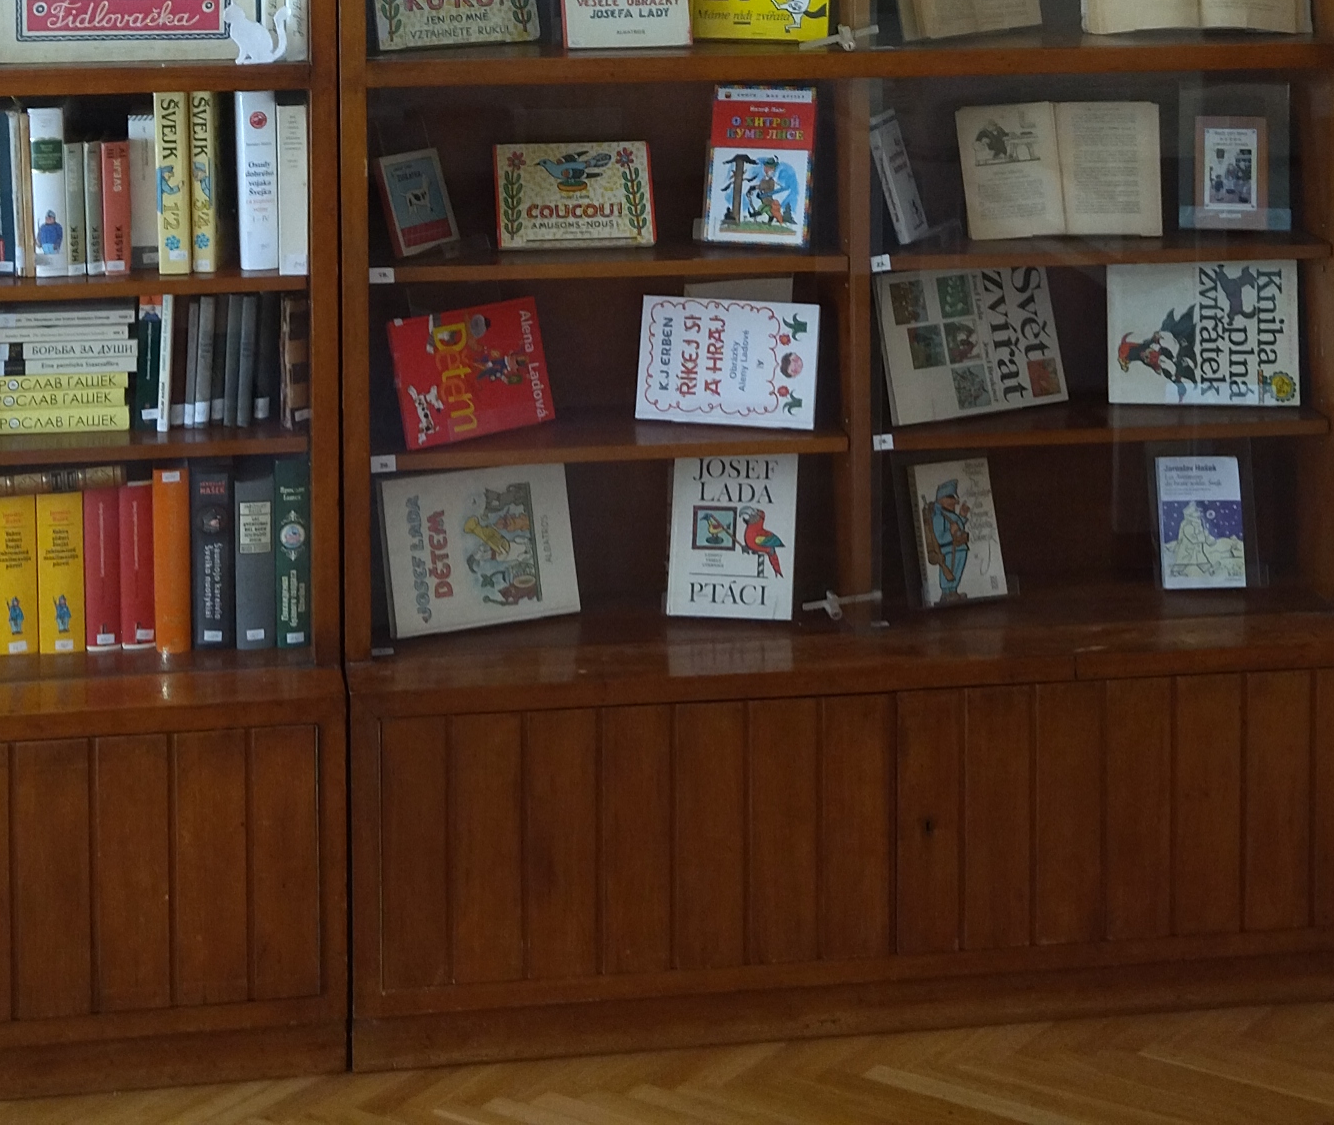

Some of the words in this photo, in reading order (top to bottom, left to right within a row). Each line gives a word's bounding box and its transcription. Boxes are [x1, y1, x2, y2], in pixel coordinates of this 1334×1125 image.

[46, 0, 200, 28] Fidlovačka
[424, 15, 445, 25] JEN
[449, 14, 463, 24] PO
[465, 9, 490, 22] MNĚ
[590, 9, 634, 19] JOSEFA
[639, 7, 670, 18] LADY
[734, 9, 752, 21] rádi
[160, 98, 180, 160] ŠVEJK
[192, 96, 209, 158] ŠVEJK
[727, 129, 763, 139] КУМЕ
[767, 129, 804, 140] ЛИСЕ
[745, 115, 800, 127] ХИТРОЙ
[113, 158, 122, 192] ŠVEJK
[246, 169, 274, 178] dobrého
[248, 161, 272, 171] Osudy
[248, 187, 272, 196] Švejka
[526, 202, 623, 219] COUCOU!
[72, 227, 80, 262] HAŠEK
[92, 227, 100, 262] HAŠEK
[116, 225, 124, 261] HAŠEK
[683, 314, 702, 334] SI
[1010, 266, 1051, 361] Svět
[1256, 268, 1284, 368] Kniha
[660, 317, 674, 369] ERBEN
[706, 315, 726, 372] HRAJ
[741, 329, 750, 364] Ladové
[981, 270, 1029, 403] zvířat
[1199, 266, 1226, 396] zvířátek
[32, 346, 75, 355] БОРЬБА
[80, 346, 95, 355] ЗА
[98, 344, 133, 355] ДУШИ
[519, 310, 535, 353] Alena
[528, 362, 549, 419] Ladová
[729, 341, 741, 379] Obrázky
[1223, 324, 1255, 402] plná
[68, 375, 117, 387] ГАШЕК
[433, 322, 477, 432] Dětem
[675, 339, 700, 398] ŘÍKEJ
[738, 366, 749, 392] Aleny
[63, 392, 112, 404] ГАШЕК
[704, 378, 722, 397] A
[68, 414, 117, 427] ГАШЕК
[693, 458, 778, 481] JOSEF
[1195, 464, 1217, 472] Hašek
[200, 486, 225, 494] HAŠEK
[699, 481, 773, 504] LADA
[406, 495, 424, 552] LADA
[540, 514, 553, 563] ALBATROS
[427, 509, 454, 599] DĚTEM
[412, 555, 433, 624] JOSEF
[690, 580, 768, 606] PTÁCI
